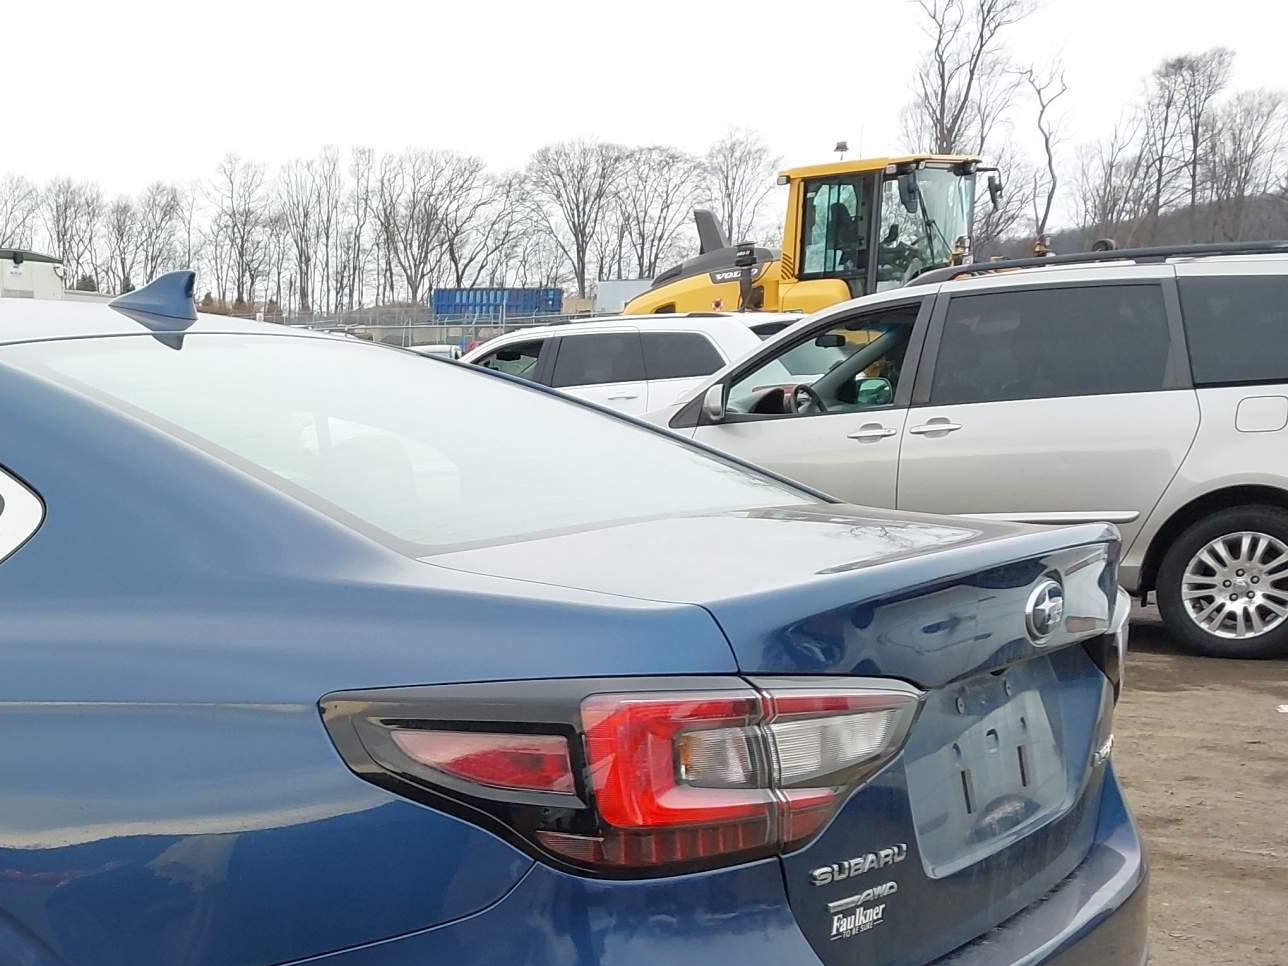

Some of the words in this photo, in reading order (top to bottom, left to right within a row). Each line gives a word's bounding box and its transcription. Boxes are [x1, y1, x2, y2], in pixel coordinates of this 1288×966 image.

[715, 268, 759, 280] VOLO
[810, 843, 907, 887] SUBARU
[856, 881, 898, 905] AWD
[830, 903, 886, 936] Faulkner
